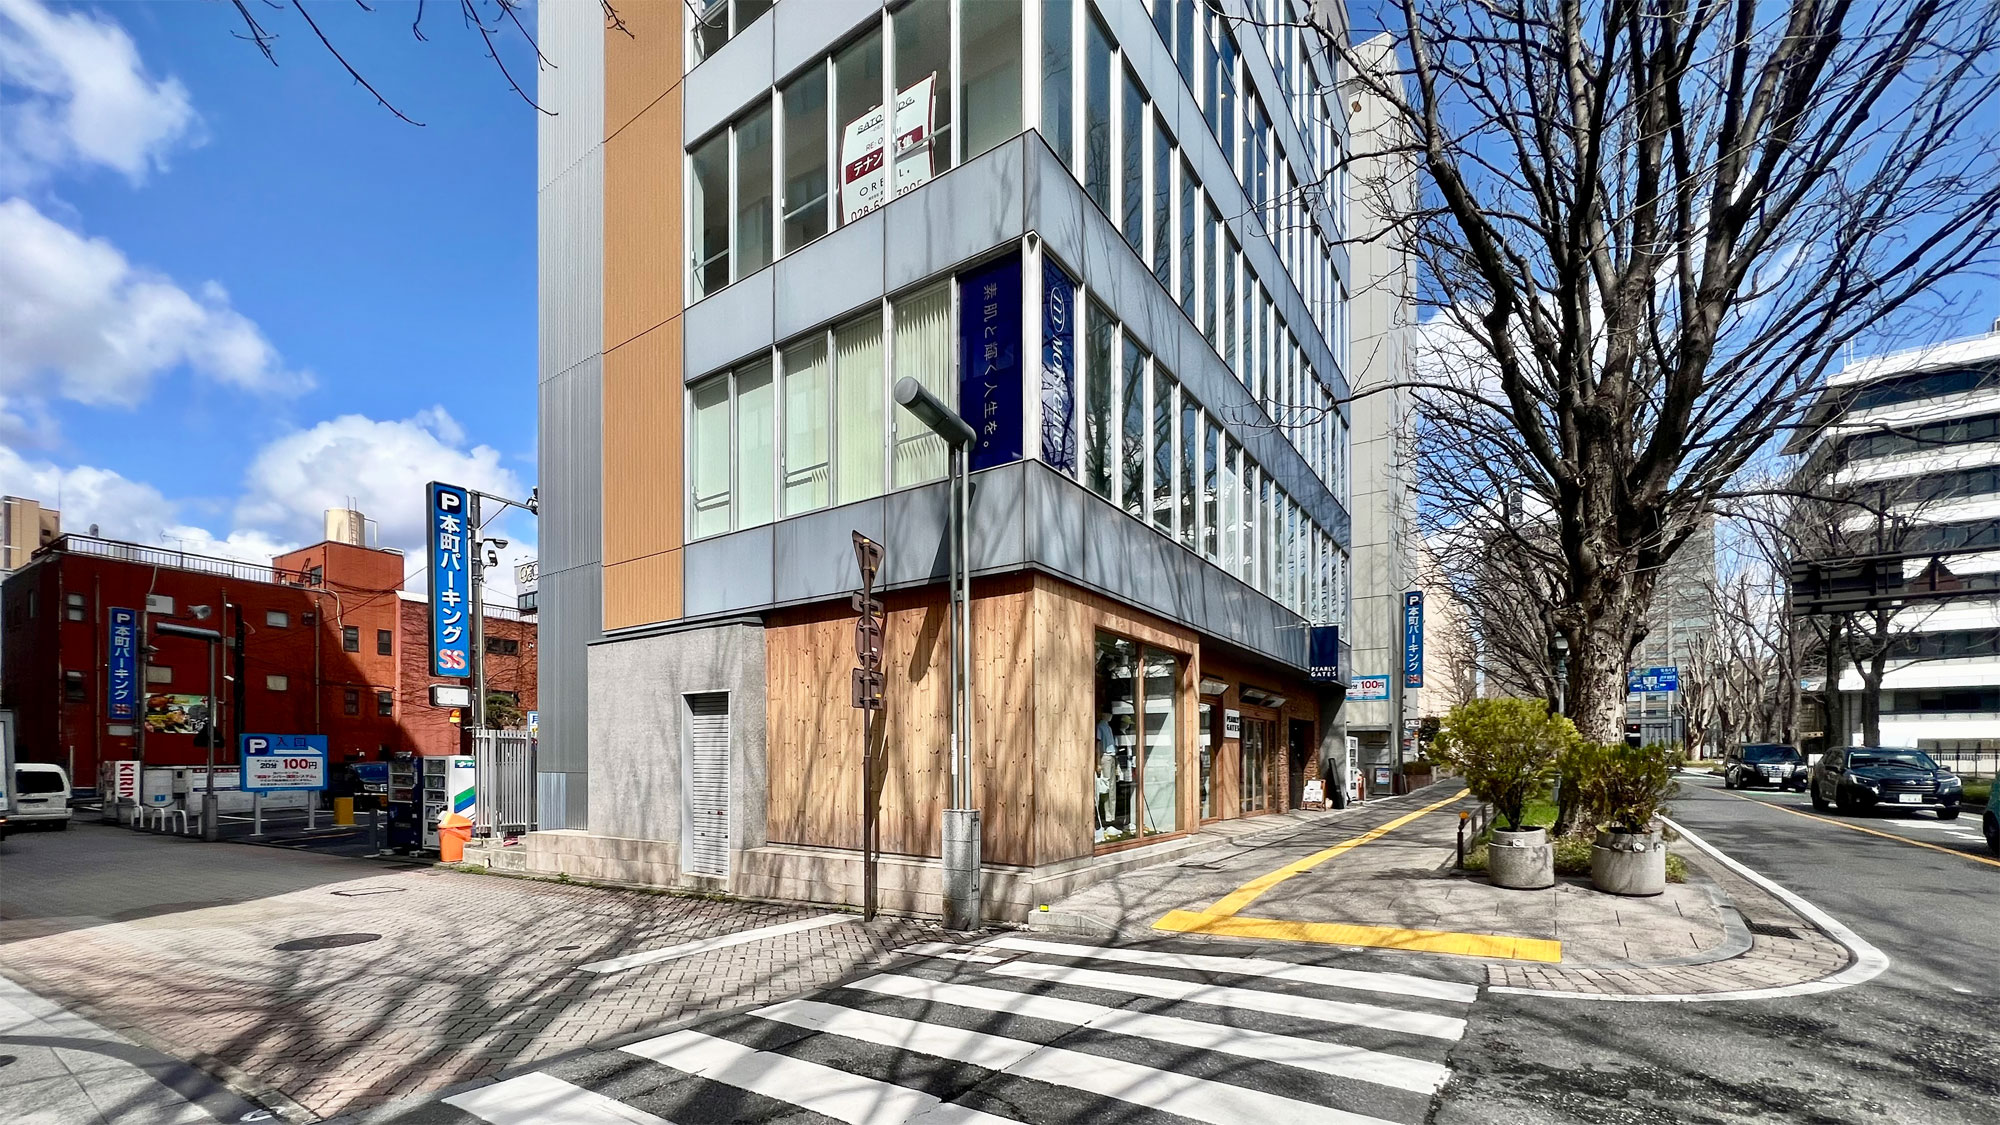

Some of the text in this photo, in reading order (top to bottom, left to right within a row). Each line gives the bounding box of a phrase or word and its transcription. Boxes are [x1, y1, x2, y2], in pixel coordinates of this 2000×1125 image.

[983, 282, 998, 449] 素肌と輝く人生を。
[441, 492, 460, 511] P
[439, 514, 463, 644] 本町パーキング
[1409, 596, 1419, 605] P
[117, 613, 131, 623] P
[1408, 606, 1419, 672] 本町パーキング
[114, 626, 131, 700] 本町パーキング
[249, 739, 268, 754] P
[283, 758, 318, 770] 100円
